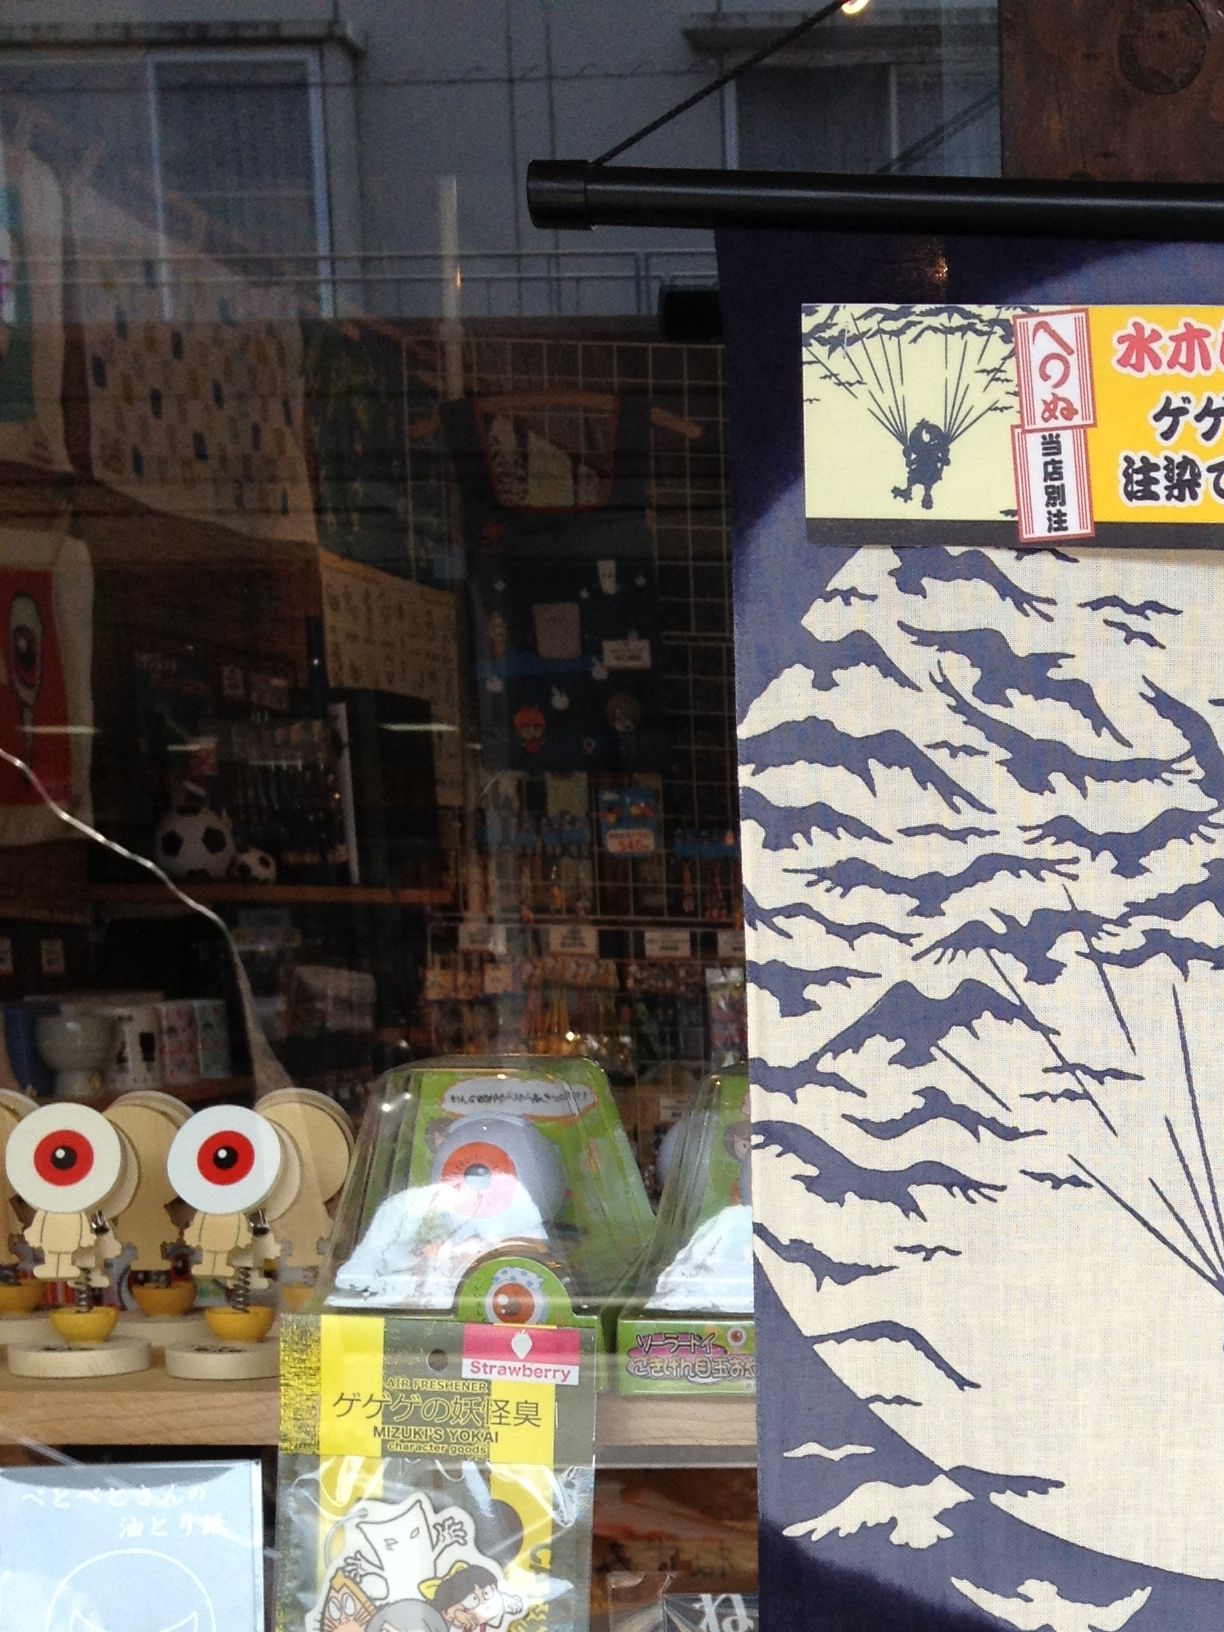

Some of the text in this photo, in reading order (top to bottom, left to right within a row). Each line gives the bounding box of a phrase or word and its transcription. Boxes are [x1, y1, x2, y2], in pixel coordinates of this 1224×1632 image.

[1041, 433, 1068, 534] 当店別注
[636, 1332, 717, 1354] ソーラートイ
[470, 1360, 571, 1383] Strawberry
[386, 1377, 489, 1393] AIR FRESHENER
[333, 1392, 542, 1428] ゲゲゲの妖怪臭
[373, 1425, 499, 1444] MIZUKI'S YOKAI
[387, 1441, 487, 1456] character goods
